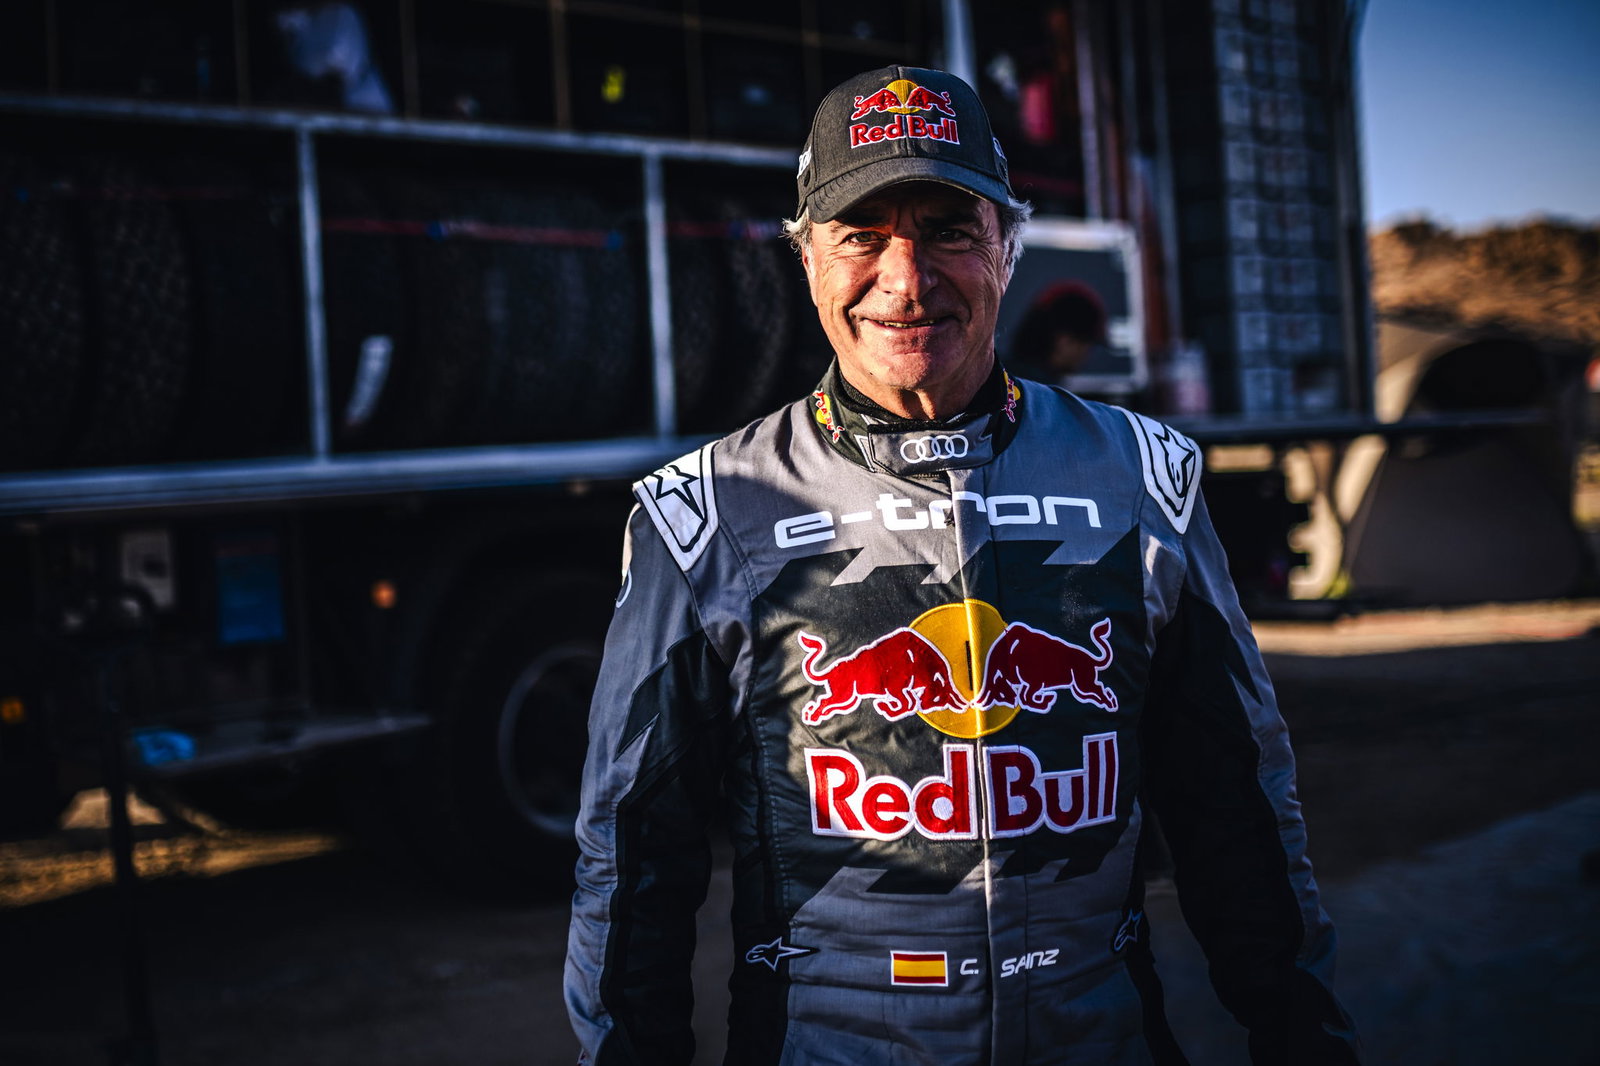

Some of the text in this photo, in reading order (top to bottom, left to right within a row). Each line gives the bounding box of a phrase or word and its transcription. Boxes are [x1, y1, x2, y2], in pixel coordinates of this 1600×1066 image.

[850, 115, 959, 148] Red Bull
[774, 491, 1102, 548] e-tron
[805, 732, 1117, 840] Red Bull
[960, 949, 1059, 978] C. SAINZ
